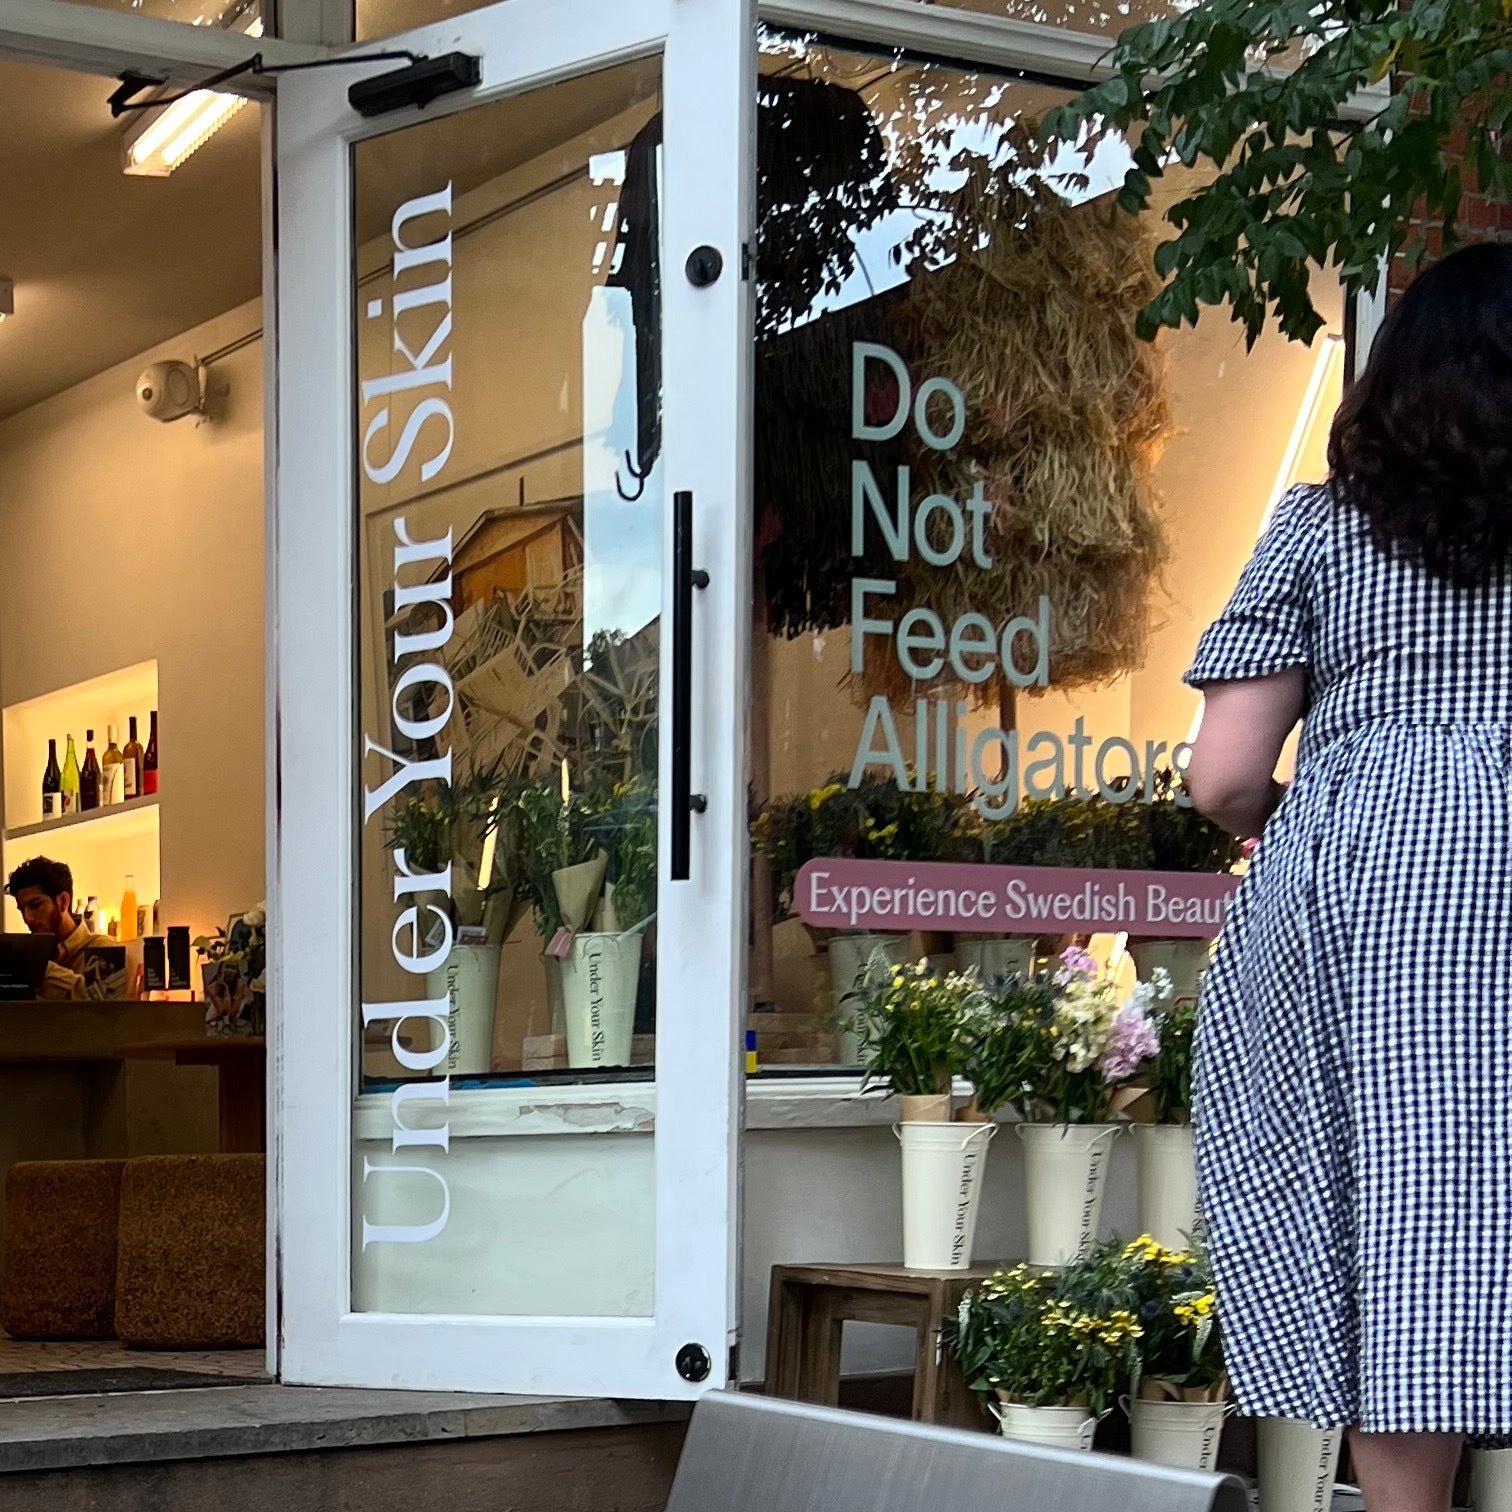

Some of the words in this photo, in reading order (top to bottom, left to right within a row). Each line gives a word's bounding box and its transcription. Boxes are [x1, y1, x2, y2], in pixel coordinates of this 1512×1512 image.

[360, 179, 456, 485] Skin
[852, 340, 966, 451] Do
[850, 459, 993, 570] Not
[850, 577, 1050, 687] Feed
[364, 515, 456, 825] Your
[808, 871, 997, 924] Experience
[1005, 878, 1137, 923] Swedish
[446, 965, 459, 1005] Under
[589, 953, 604, 995] Under
[591, 997, 604, 1029] Your
[362, 847, 455, 1253] Under
[448, 1041, 460, 1070] Skin
[592, 1031, 605, 1062] Skin
[960, 1154, 977, 1196] Under
[1086, 1151, 1104, 1195] Under
[955, 1200, 970, 1231] Your
[1080, 1197, 1097, 1228] Your
[950, 1234, 966, 1266] Skin
[1314, 1473, 1330, 1505] Your
